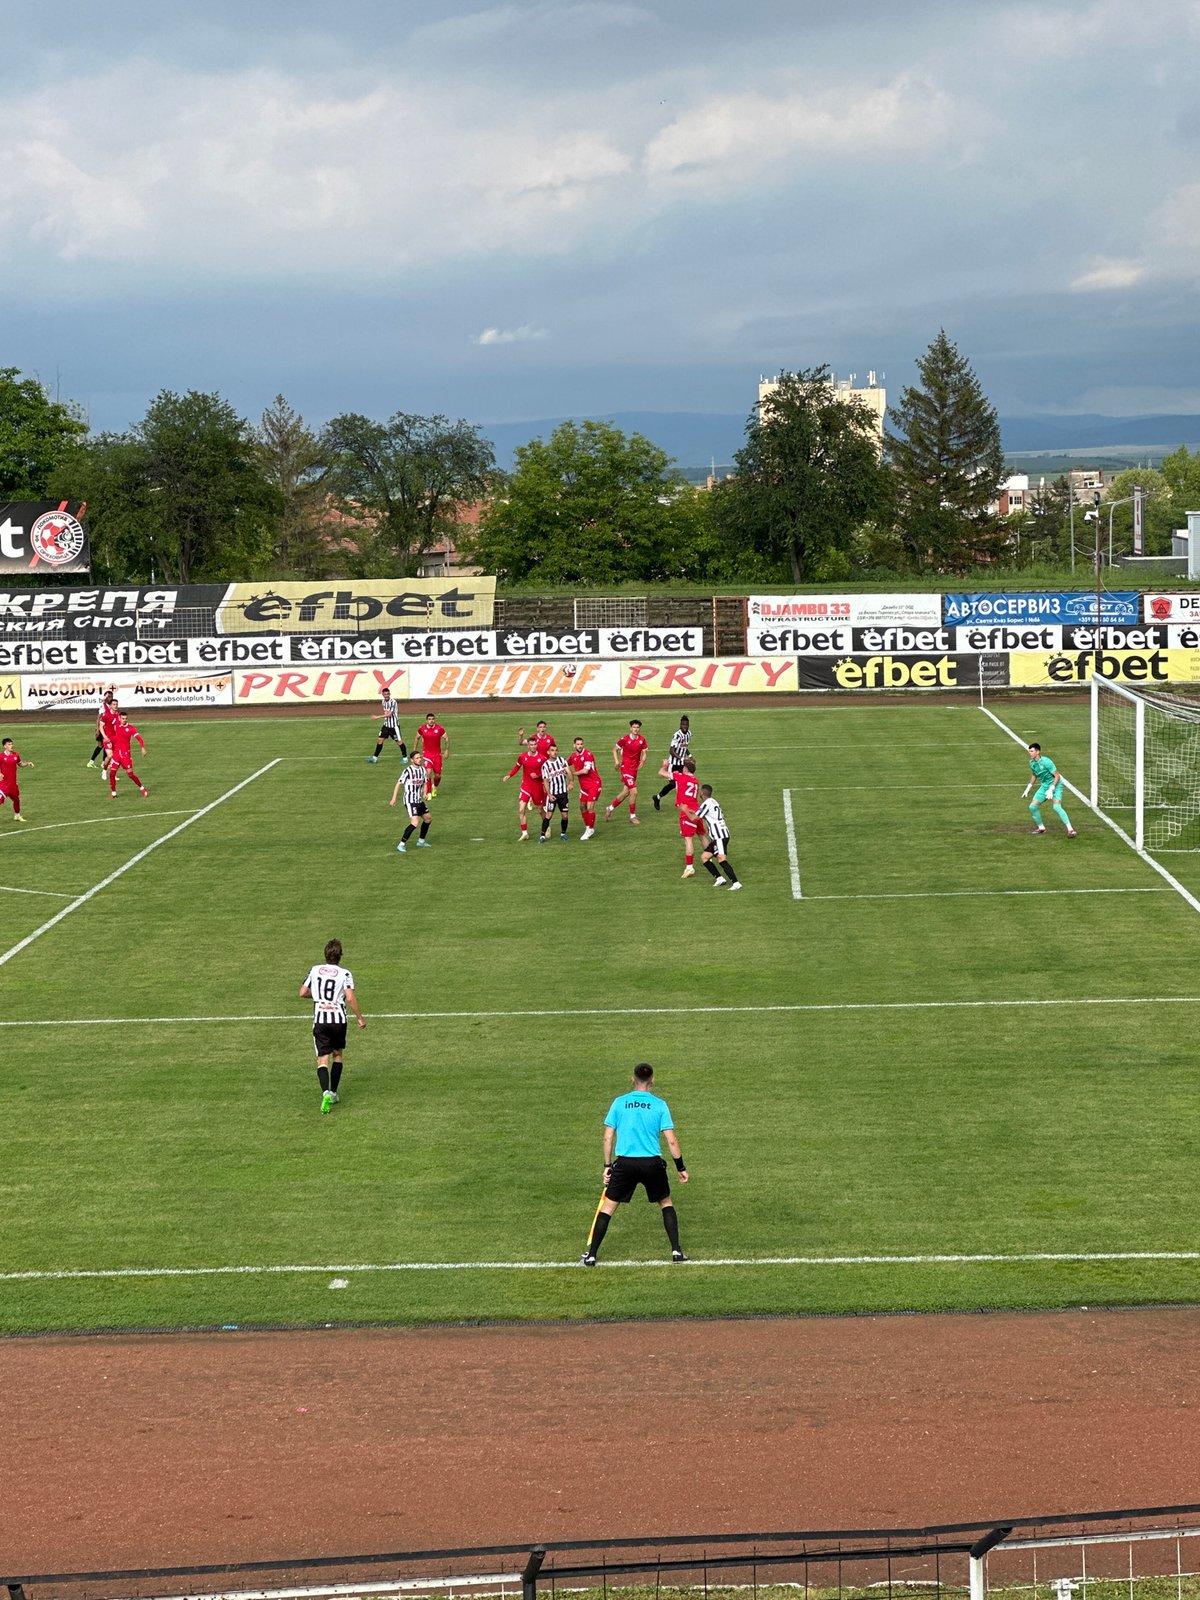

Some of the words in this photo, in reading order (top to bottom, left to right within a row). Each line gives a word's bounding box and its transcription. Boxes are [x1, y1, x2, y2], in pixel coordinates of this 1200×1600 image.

[242, 587, 475, 622] efbet
[761, 603, 828, 615] DJAMBO
[830, 603, 851, 615] 33
[947, 598, 1061, 617] АВТОСЕРВИЗ
[0, 618, 65, 632] КИЯ
[300, 636, 387, 660] efbet
[404, 633, 489, 657] efbet
[506, 630, 593, 655] efbet
[610, 629, 695, 653] efbet
[759, 628, 844, 652] efbet
[863, 627, 949, 651] efbet
[968, 627, 1053, 650] efbet
[1073, 626, 1160, 649] efbet
[0, 643, 78, 666] efbet
[95, 640, 182, 664] efbet
[199, 638, 283, 662] efbet
[624, 661, 795, 690] PRITY
[835, 655, 957, 688] efbet
[1047, 650, 1169, 682] efbet
[28, 682, 106, 698] АБСОЛЮТ
[134, 680, 211, 694] АБСОЛЮТ
[238, 669, 406, 698] PRITY
[427, 664, 602, 695] BULTRAF
[144, 694, 215, 703] www.absolutplus.bg
[684, 781, 698, 799] 21
[317, 976, 336, 1002] 18
[624, 1101, 652, 1110] inbet
